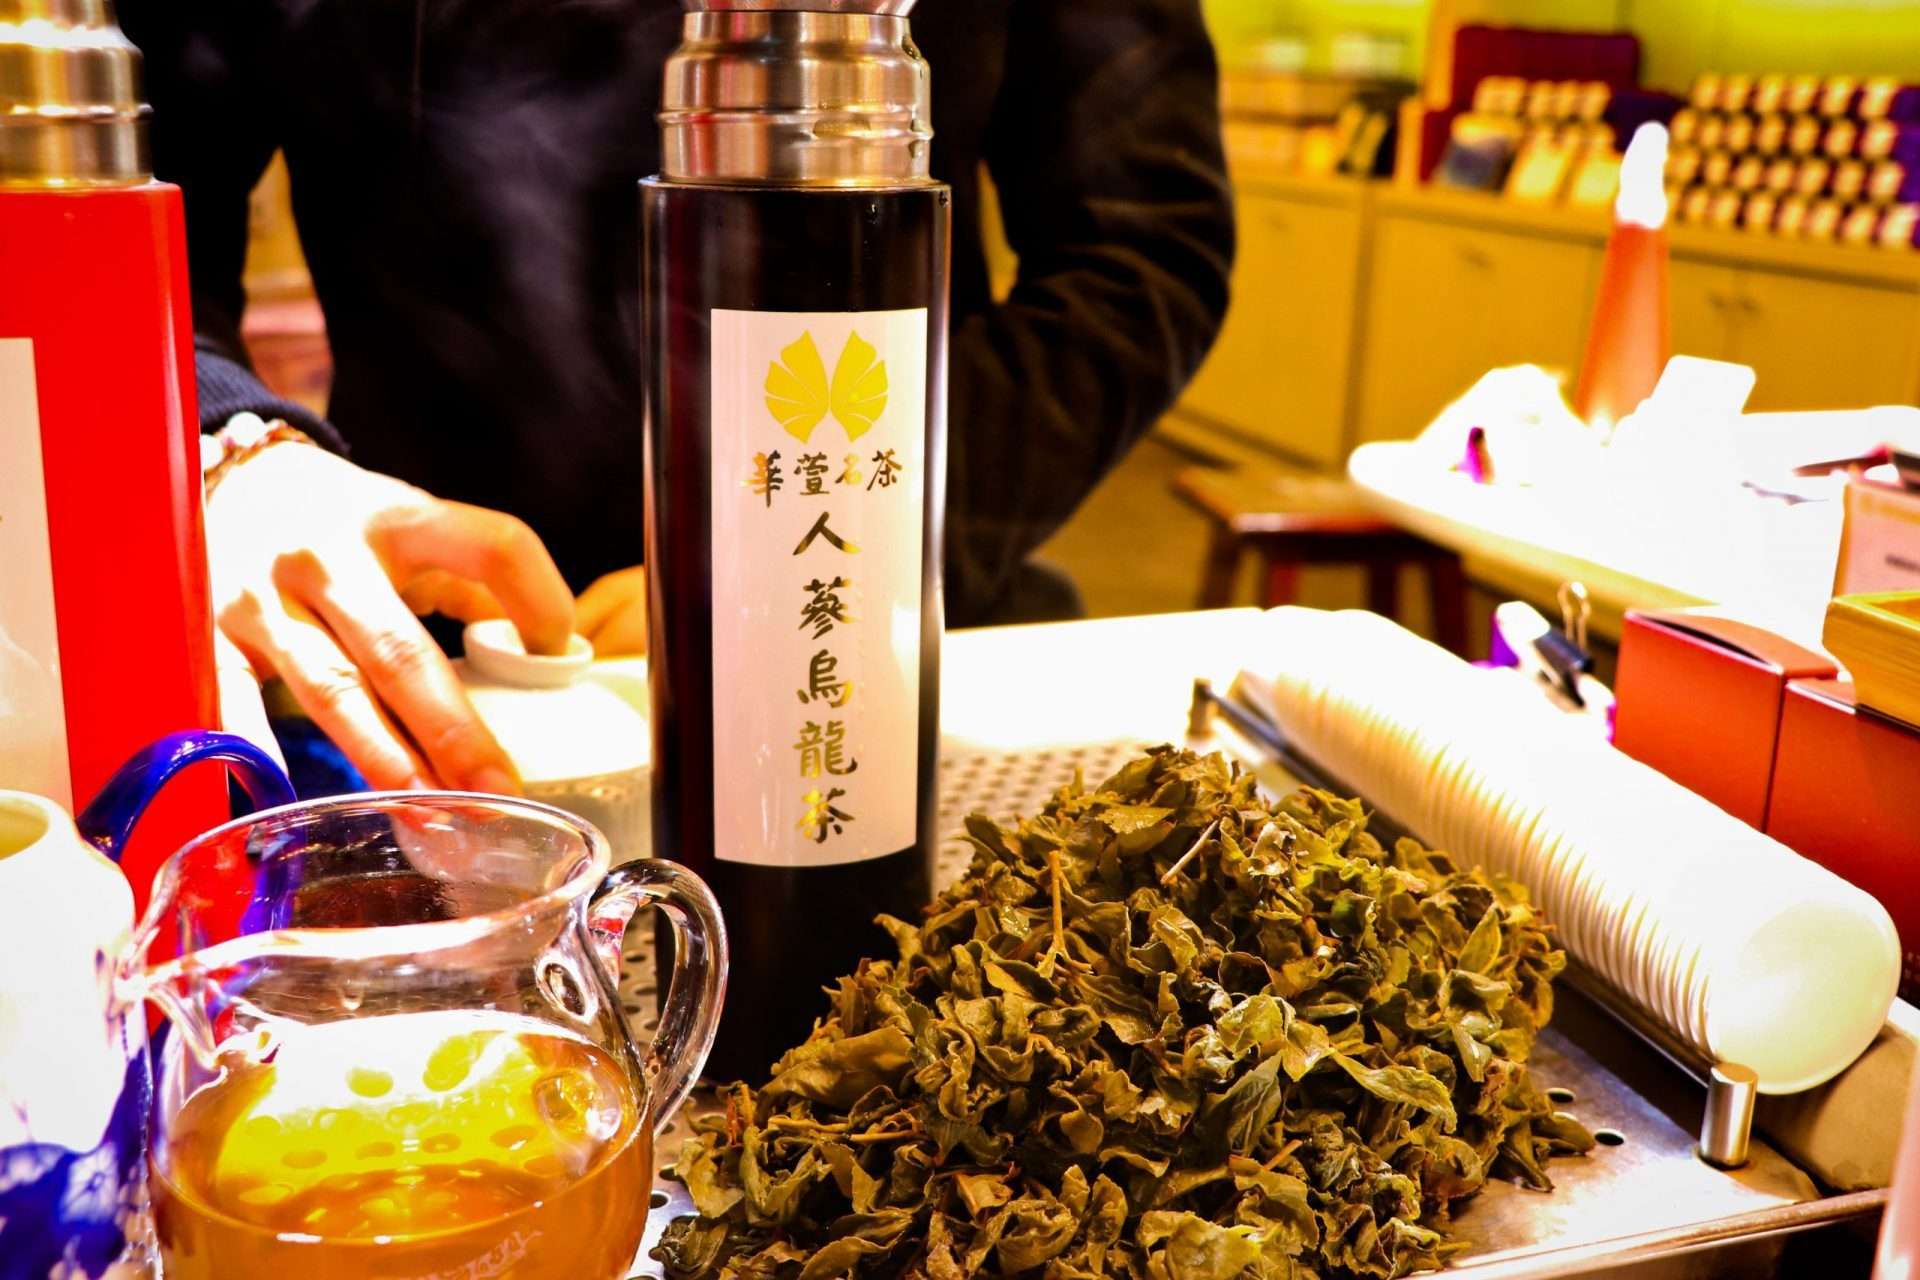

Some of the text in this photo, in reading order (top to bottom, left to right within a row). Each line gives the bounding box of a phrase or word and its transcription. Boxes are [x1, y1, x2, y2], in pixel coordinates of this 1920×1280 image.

[741, 449, 903, 508] 華萱名茶
[793, 511, 861, 843] 人蔘烏龍茶
